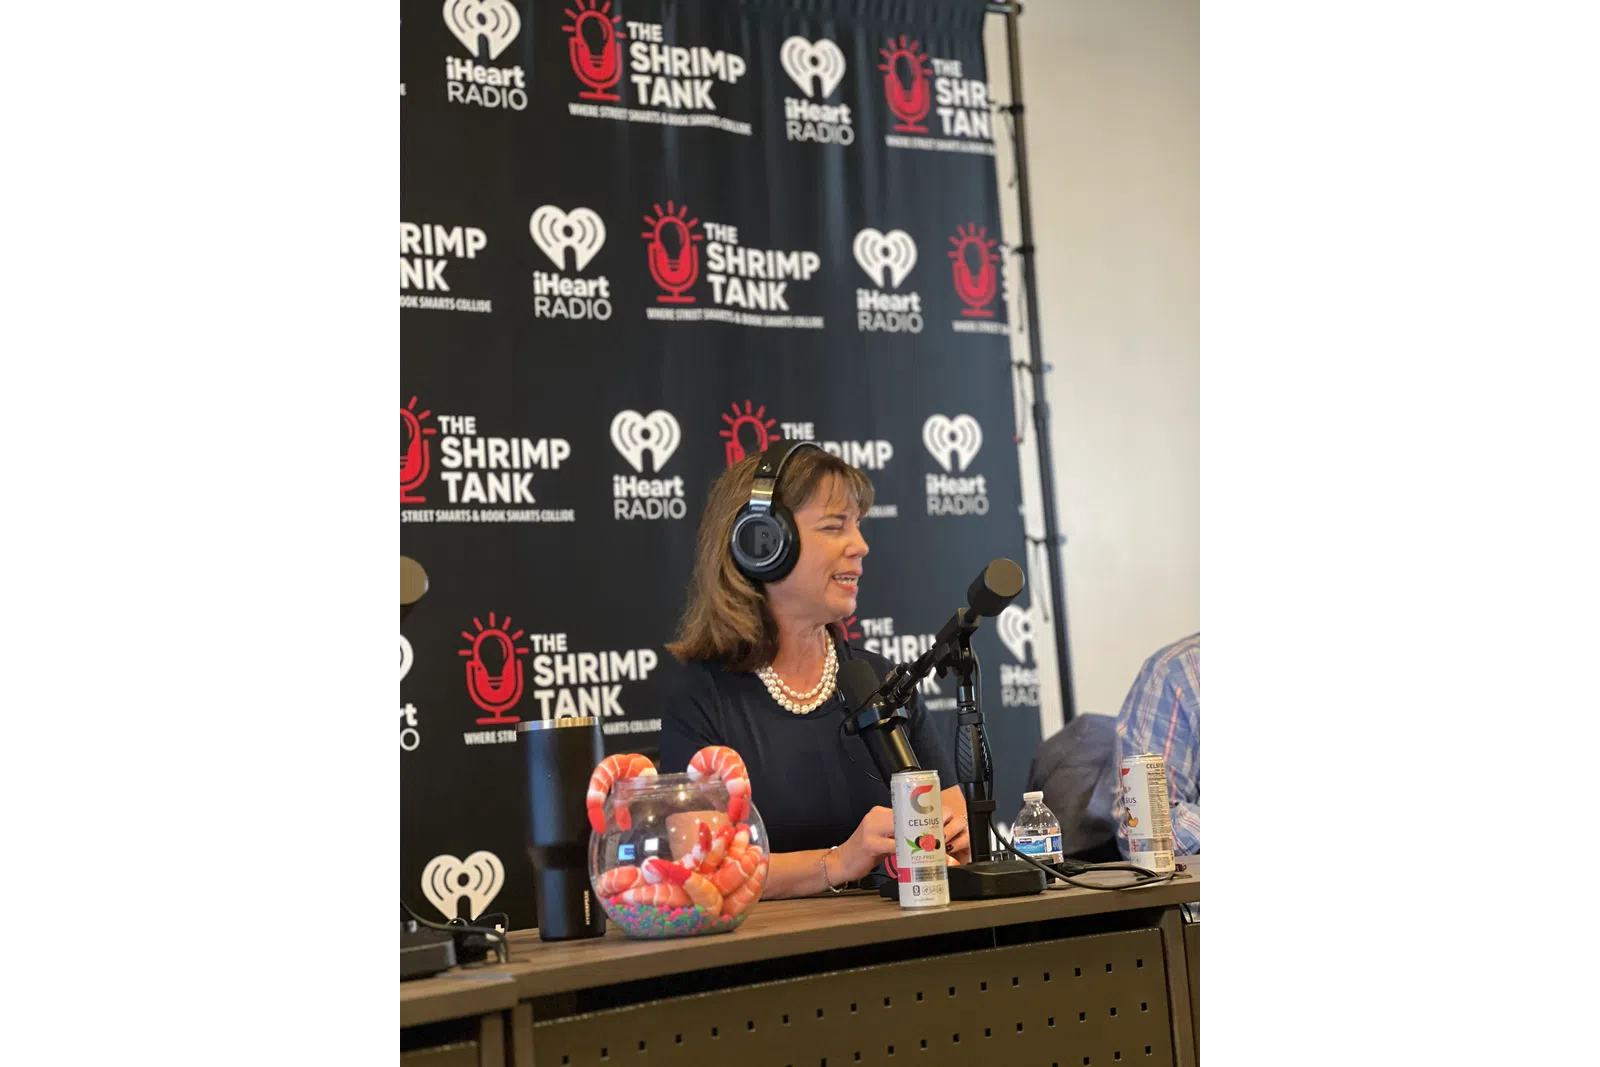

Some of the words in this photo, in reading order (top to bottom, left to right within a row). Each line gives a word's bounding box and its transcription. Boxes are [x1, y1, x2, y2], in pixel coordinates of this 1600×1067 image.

[626, 21, 663, 42] THE
[446, 56, 525, 88] iHeart
[629, 42, 746, 84] SHRIMP
[931, 58, 963, 78] THE
[447, 81, 528, 111] RADIO
[631, 75, 716, 110] TANK
[784, 97, 852, 125] iHeart
[936, 107, 991, 139] TAN
[786, 120, 855, 146] RADIO
[703, 222, 739, 244] THE
[706, 242, 821, 281] SHRIMP
[533, 271, 610, 298] iHeart
[707, 274, 789, 311] TANK
[419, 296, 455, 310] SMARTS
[455, 298, 493, 313] COLLIDE
[534, 296, 612, 321] RADIO
[856, 288, 921, 312] iHeart
[857, 312, 923, 334] RADIO
[437, 416, 476, 435] THE
[780, 422, 815, 441] THE
[440, 437, 570, 470] SHRIMP
[816, 440, 894, 470] RIMP
[440, 472, 536, 504] TANK
[612, 475, 684, 498] iHeart
[925, 474, 987, 496] iHeart
[401, 509, 434, 523] STREET
[435, 509, 471, 523] SMARTS
[472, 509, 480, 523] &
[480, 509, 506, 523] BOOK
[506, 509, 540, 523] SMARTS
[540, 509, 575, 523] COLLIDE
[614, 499, 687, 520] RADIO
[927, 497, 989, 516] RADIO
[860, 616, 894, 638] THE
[530, 633, 568, 653] THE
[533, 649, 658, 687] SHRIMP
[533, 683, 625, 722] TANK
[463, 732, 497, 746] WHERE
[602, 721, 630, 736] MARTS
[630, 718, 662, 734] COLLIDE
[908, 817, 940, 827] CELSIUS
